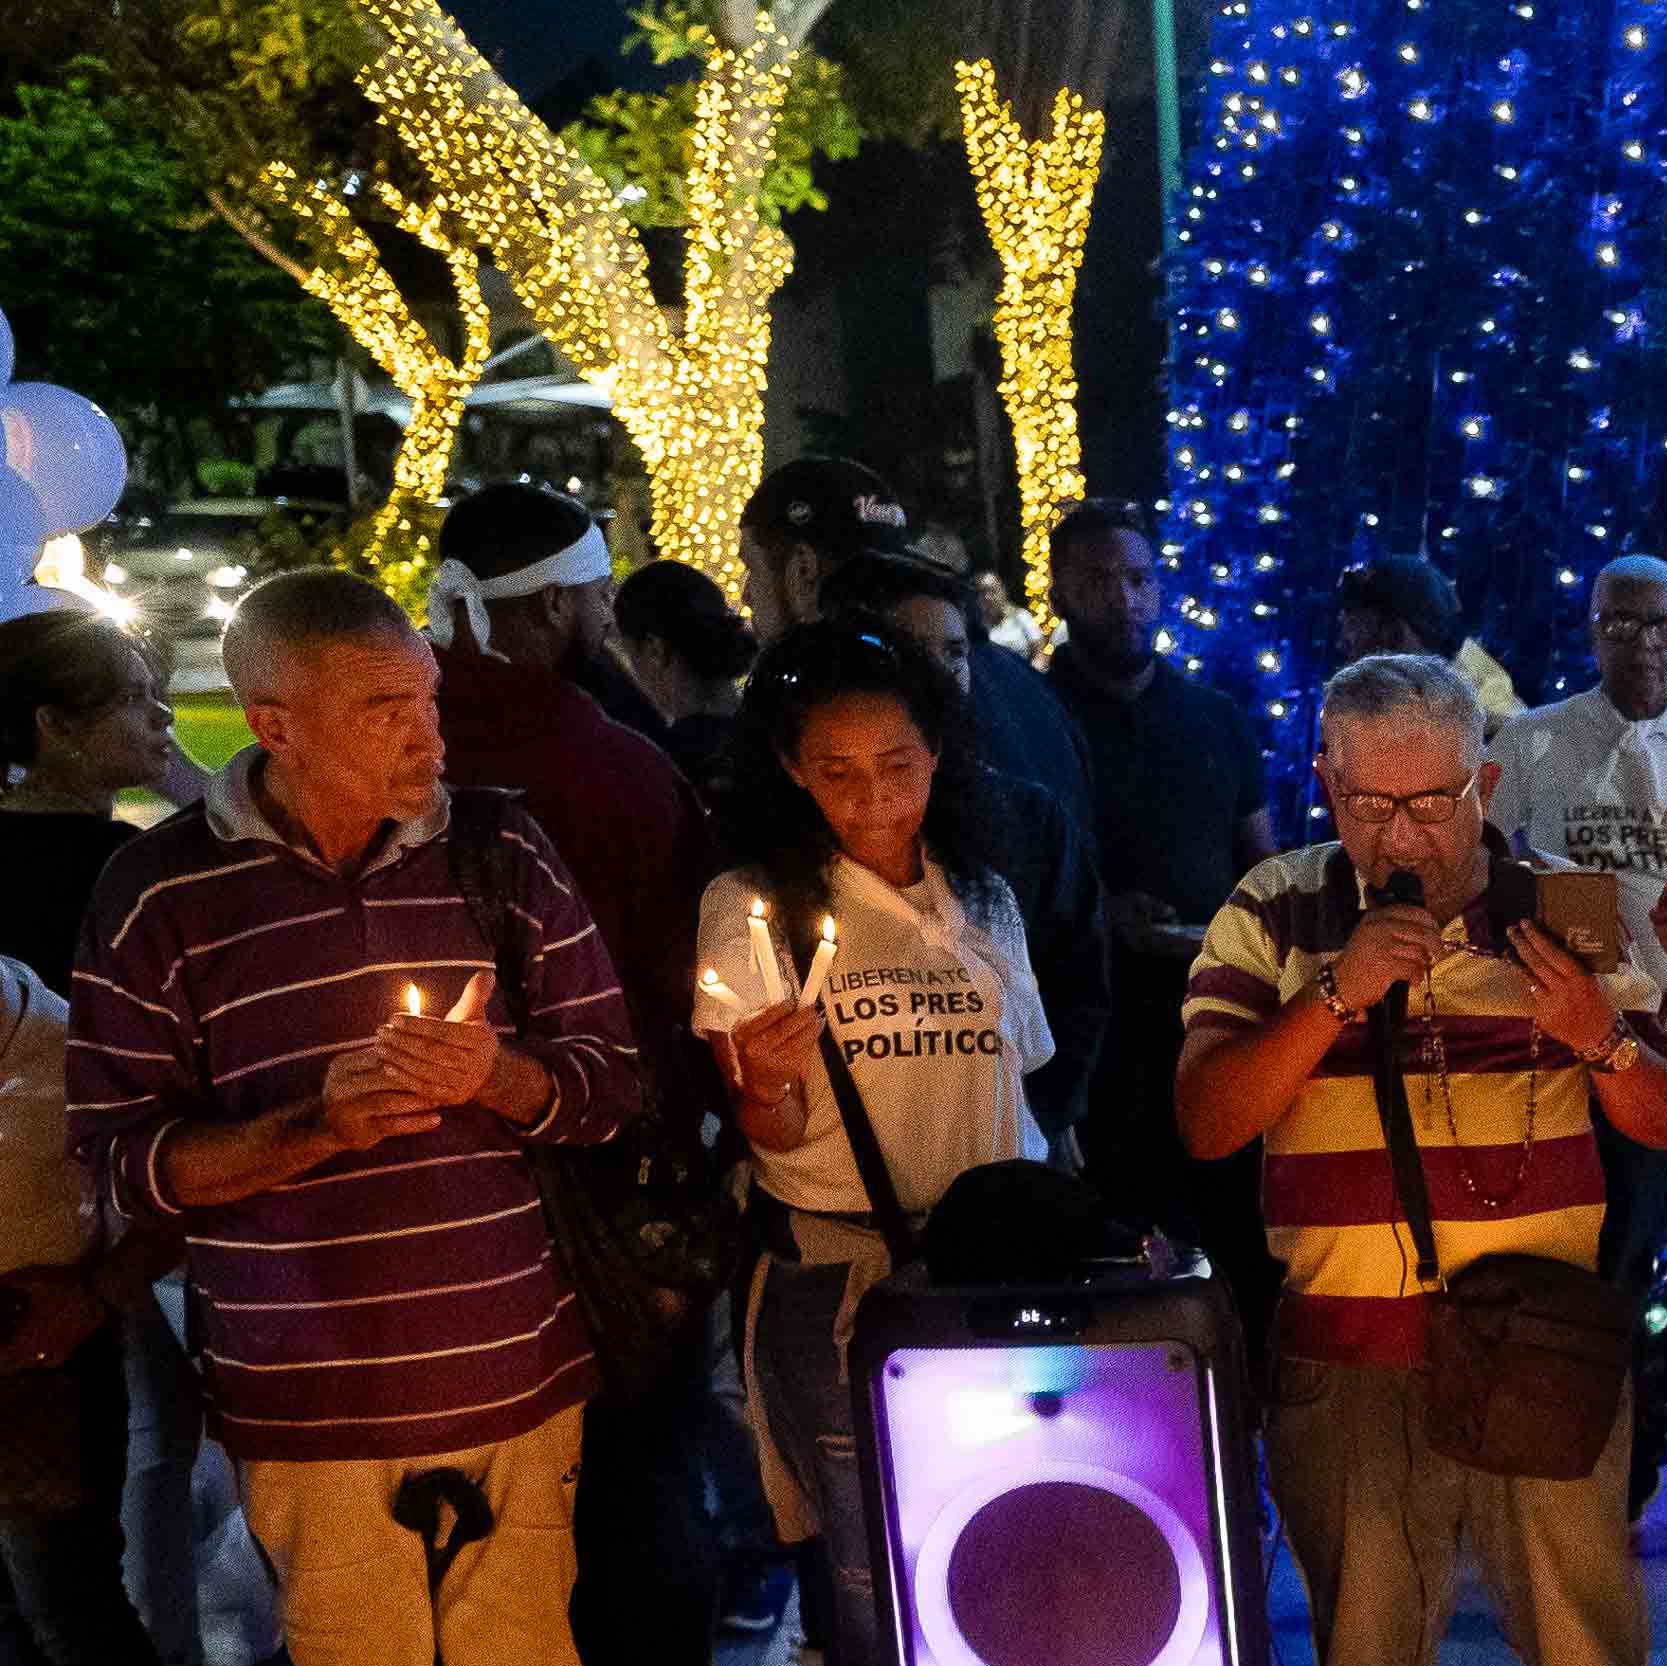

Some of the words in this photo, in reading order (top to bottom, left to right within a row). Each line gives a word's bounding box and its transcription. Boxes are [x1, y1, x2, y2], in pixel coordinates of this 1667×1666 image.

[828, 967, 922, 994] LIBEREN
[927, 970, 943, 986] A
[942, 967, 971, 984] TO
[834, 993, 899, 1026] LOS
[910, 990, 984, 1015] PRES
[843, 1017, 1002, 1065] POLÍTICO
